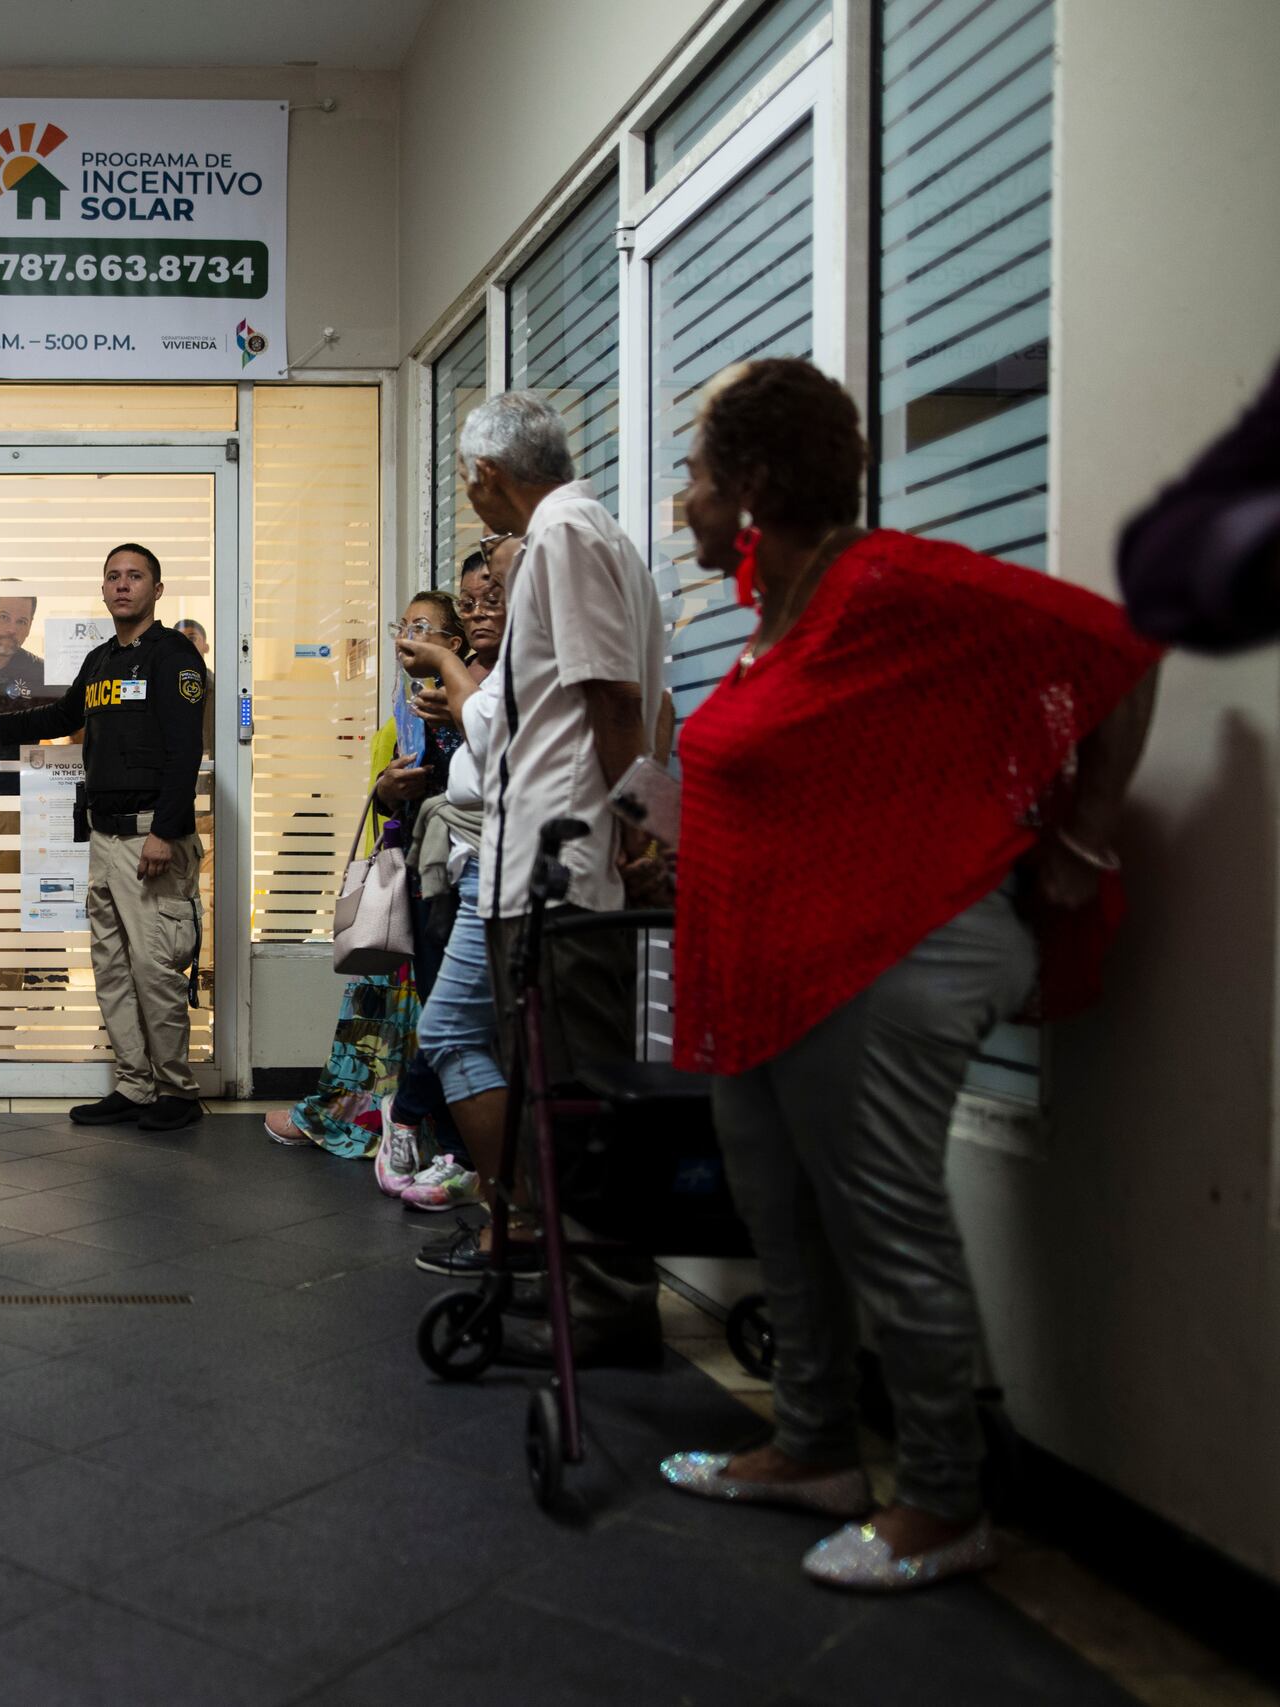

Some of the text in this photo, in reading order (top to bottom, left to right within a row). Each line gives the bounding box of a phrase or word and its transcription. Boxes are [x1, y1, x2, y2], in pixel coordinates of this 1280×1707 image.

[81, 152, 232, 168] PROGRAMA DE
[83, 170, 263, 196] INCENTIVO
[80, 197, 194, 222] SOLAR
[45, 333, 88, 350] 5:00
[94, 334, 136, 351] P.M.
[162, 341, 217, 350] VIVIENDA
